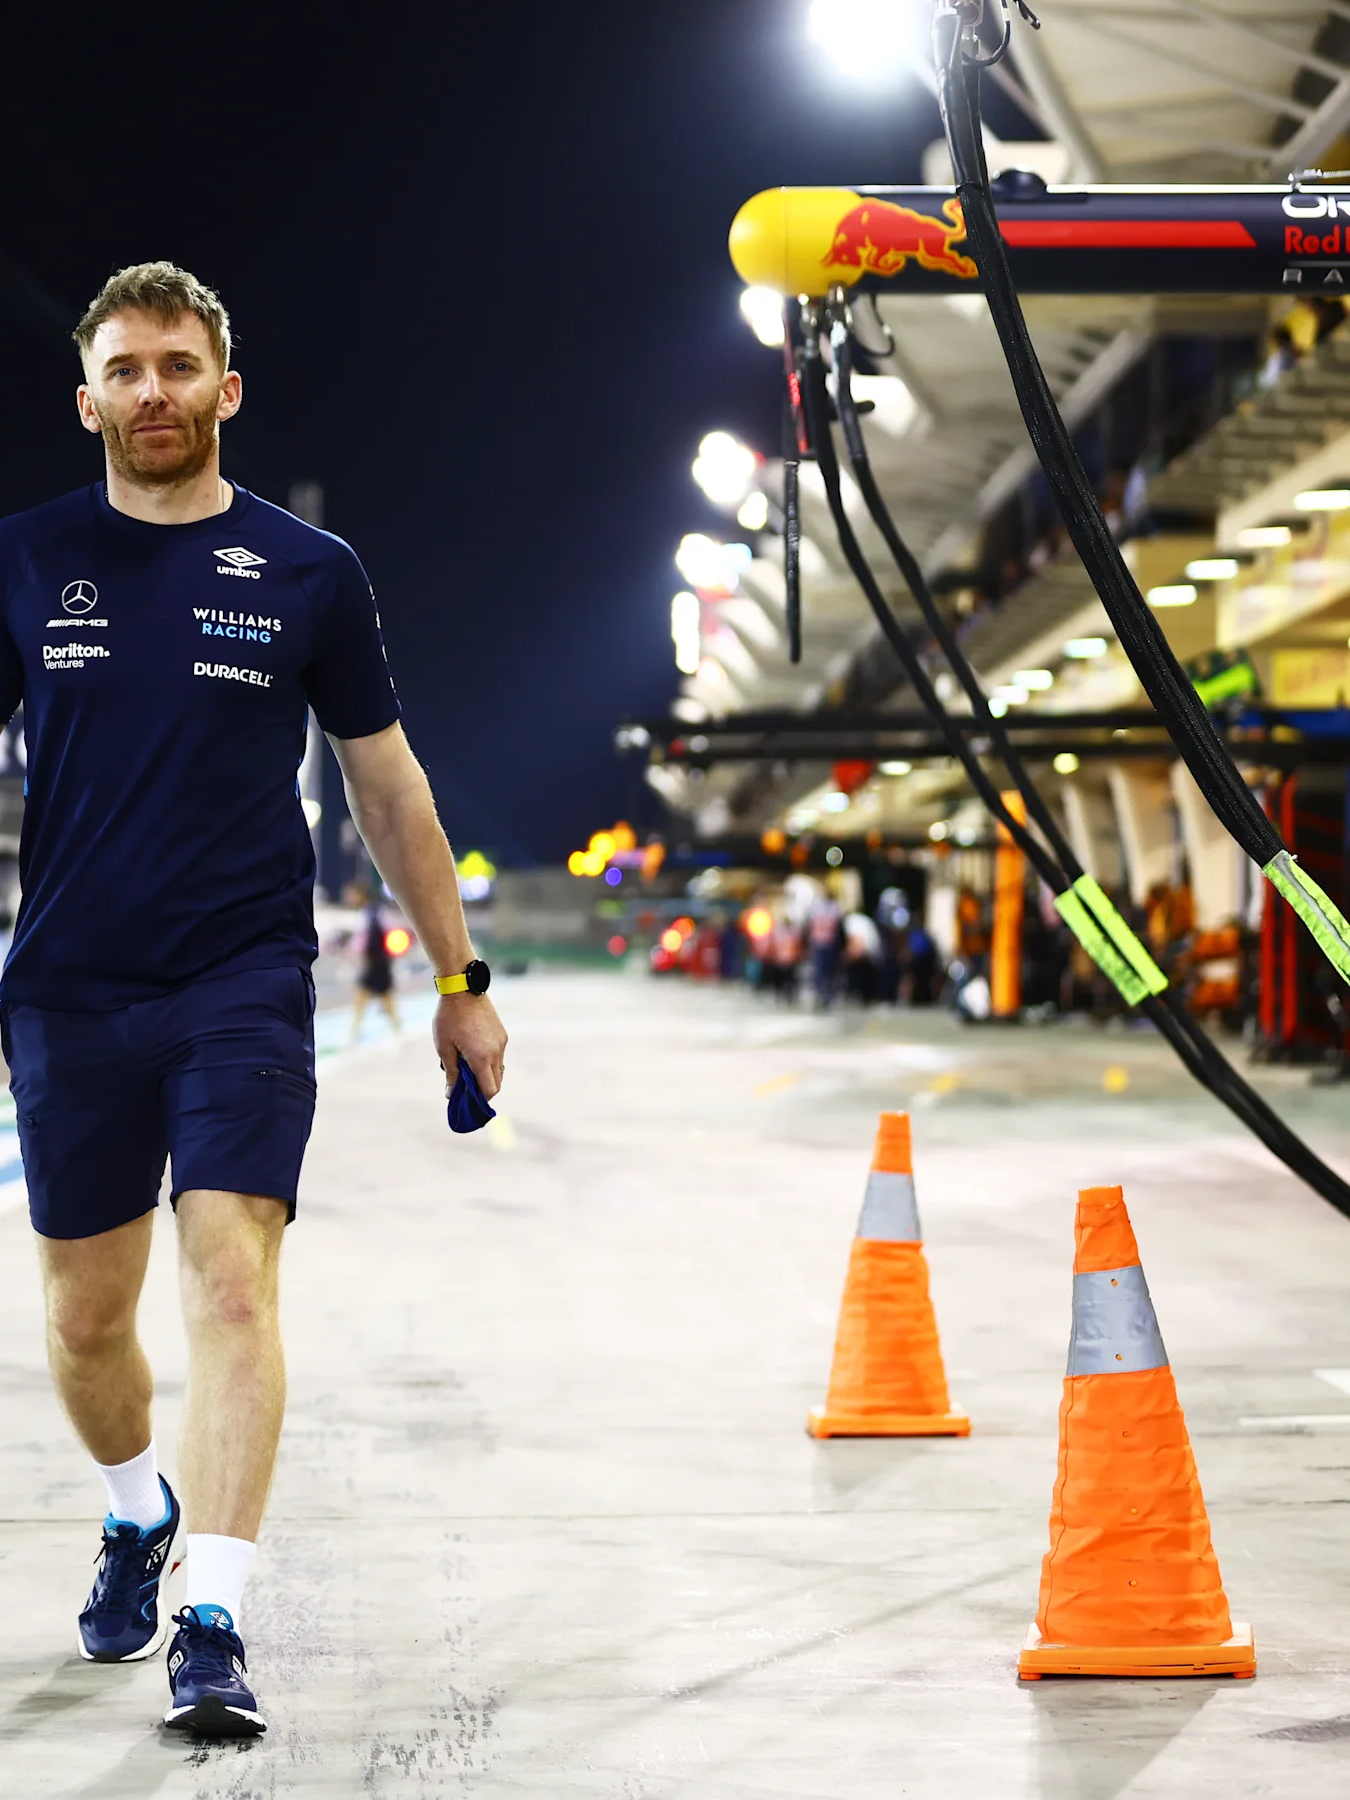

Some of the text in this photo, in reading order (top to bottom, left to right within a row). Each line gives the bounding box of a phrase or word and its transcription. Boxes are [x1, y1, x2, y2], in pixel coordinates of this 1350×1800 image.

[1284, 223, 1341, 255] Red
[216, 565, 262, 580] umbro
[66, 618, 109, 628] AMG
[192, 607, 282, 632] WILLIAMS
[202, 622, 272, 644] RACING
[44, 659, 85, 670] Ventures
[193, 661, 273, 688] DURACELL
